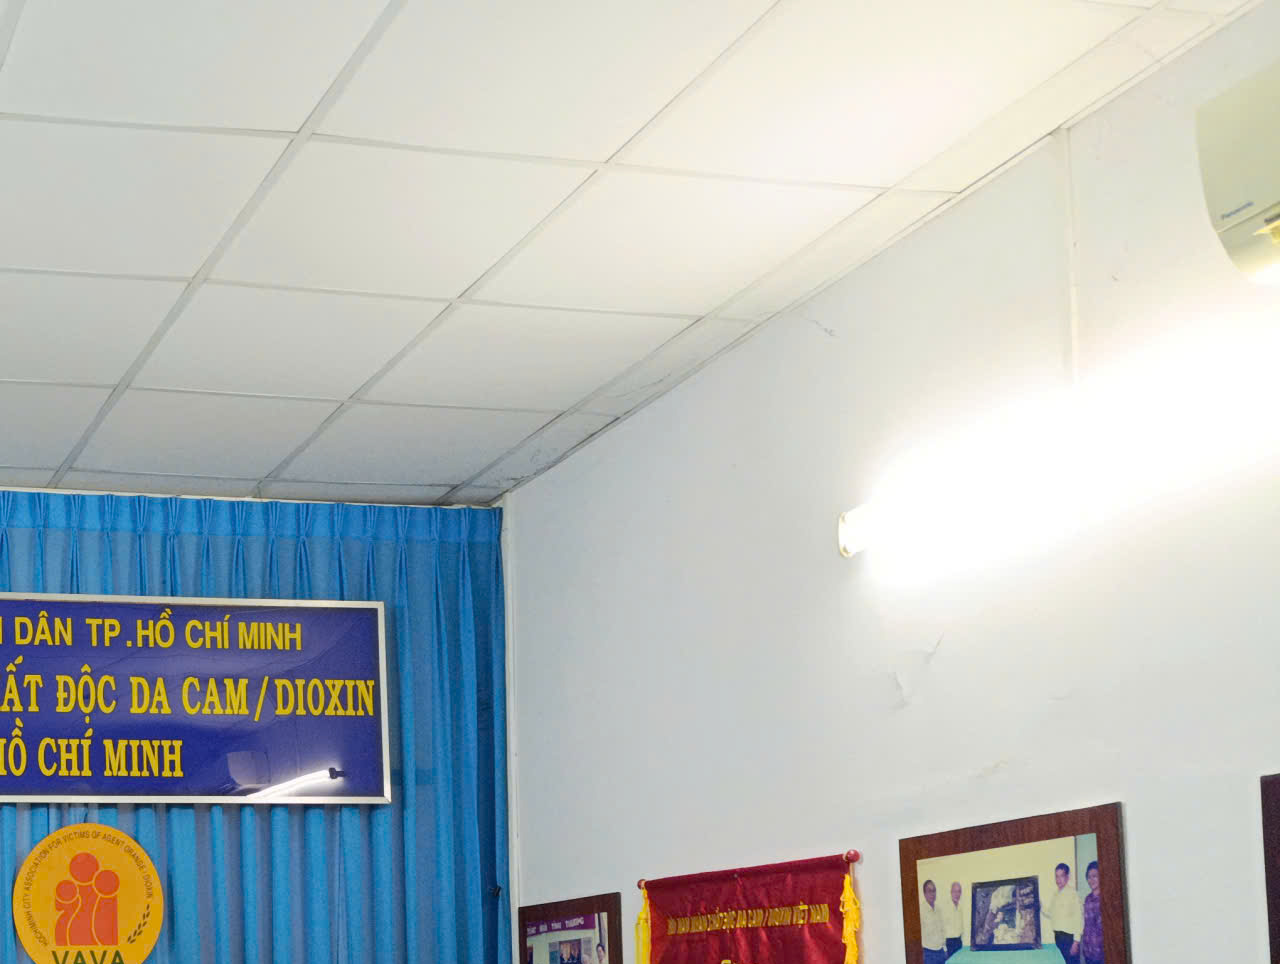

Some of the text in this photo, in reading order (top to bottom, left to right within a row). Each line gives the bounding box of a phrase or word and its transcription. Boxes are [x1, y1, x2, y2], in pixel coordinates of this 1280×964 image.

[14, 610, 73, 646] DÂN
[184, 614, 231, 649] CHÍ
[238, 621, 302, 651] MINH
[55, 663, 117, 724] ĐỘC
[129, 676, 172, 715] DA
[37, 727, 94, 777] CHÍ
[102, 739, 184, 778] MINH
[48, 838, 62, 850] FOR
[63, 831, 90, 843] VICTIMS
[91, 830, 101, 839] OF
[102, 832, 125, 848] AGENT
[123, 845, 145, 871] ORANGE
[24, 849, 49, 891] ASSOCIATION
[23, 894, 31, 909] CITY
